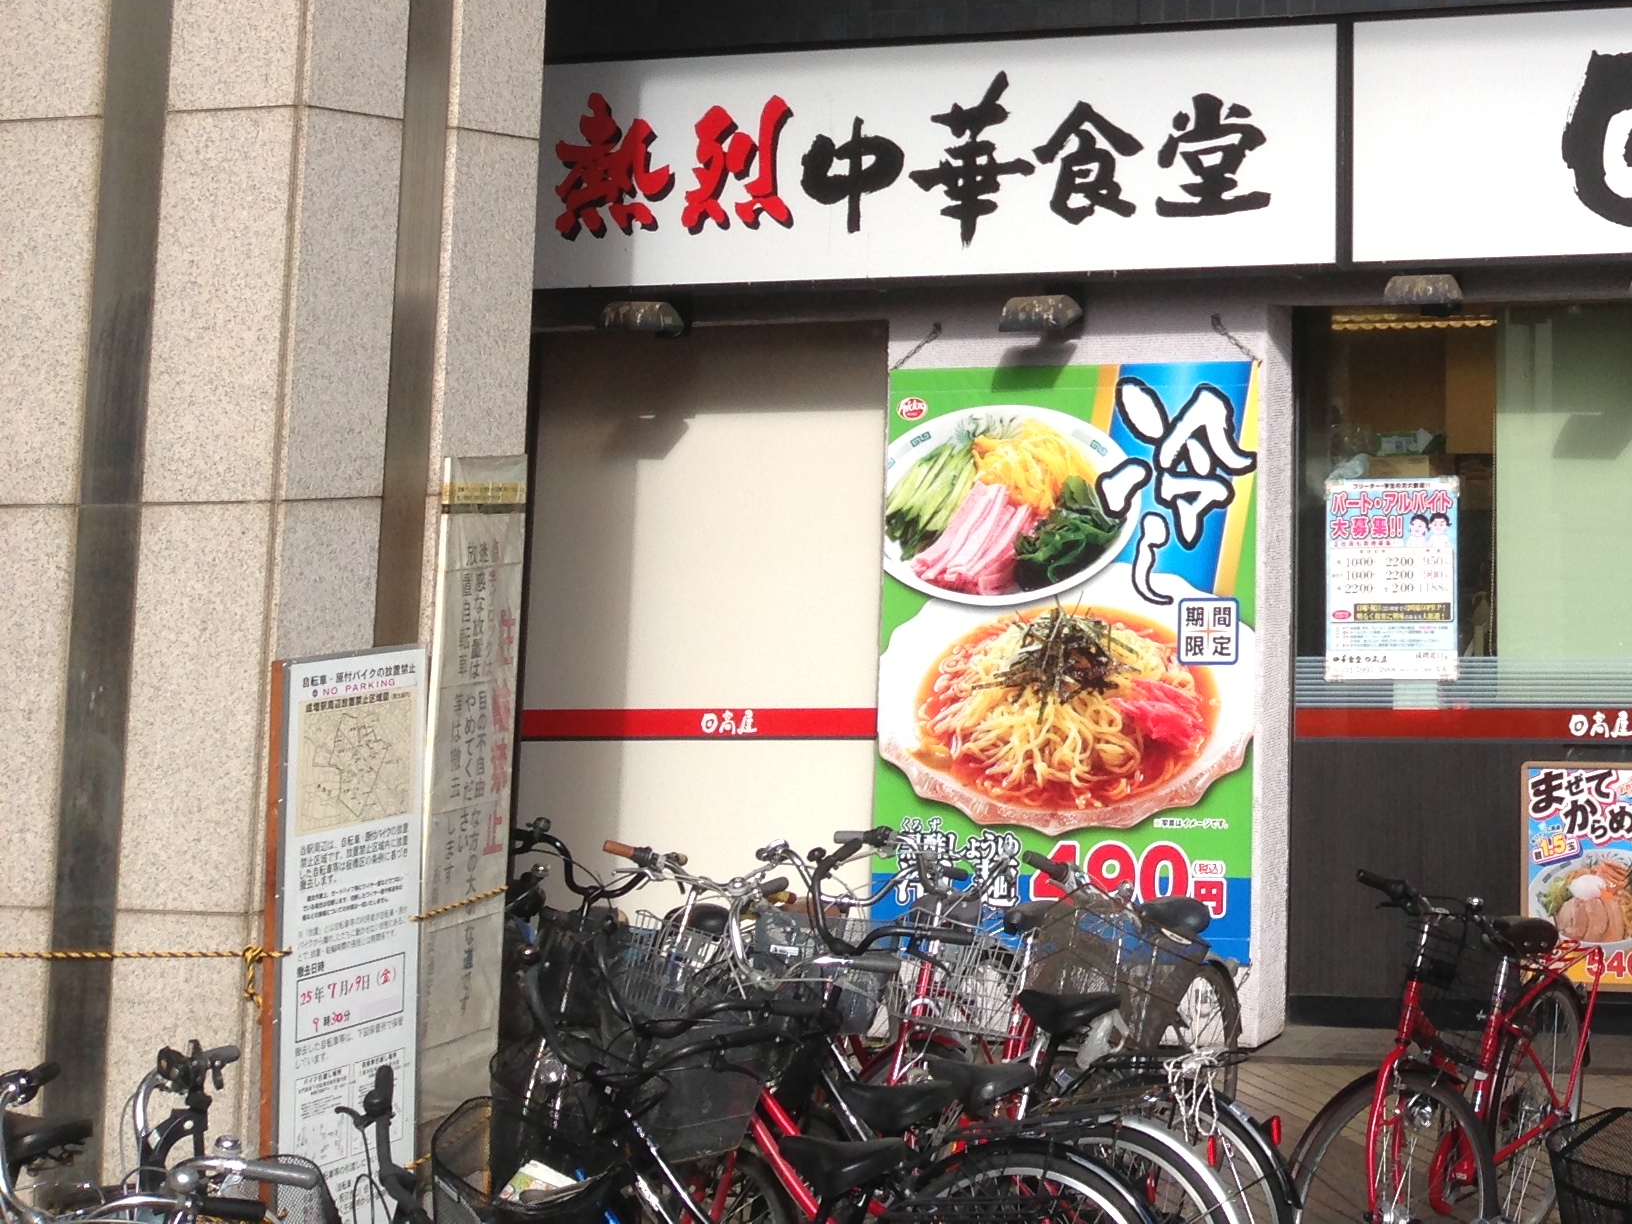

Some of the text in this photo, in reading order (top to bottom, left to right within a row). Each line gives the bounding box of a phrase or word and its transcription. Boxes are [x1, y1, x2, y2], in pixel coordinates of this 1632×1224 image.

[1095, 376, 1258, 604] 冷し
[1331, 491, 1453, 515] パート・アルバイト
[1184, 605, 1232, 629] 期間
[1184, 635, 1232, 658] 限定
[322, 678, 396, 696] NO PARKING
[701, 709, 758, 735] 日高屋
[1530, 770, 1613, 814] まぜて
